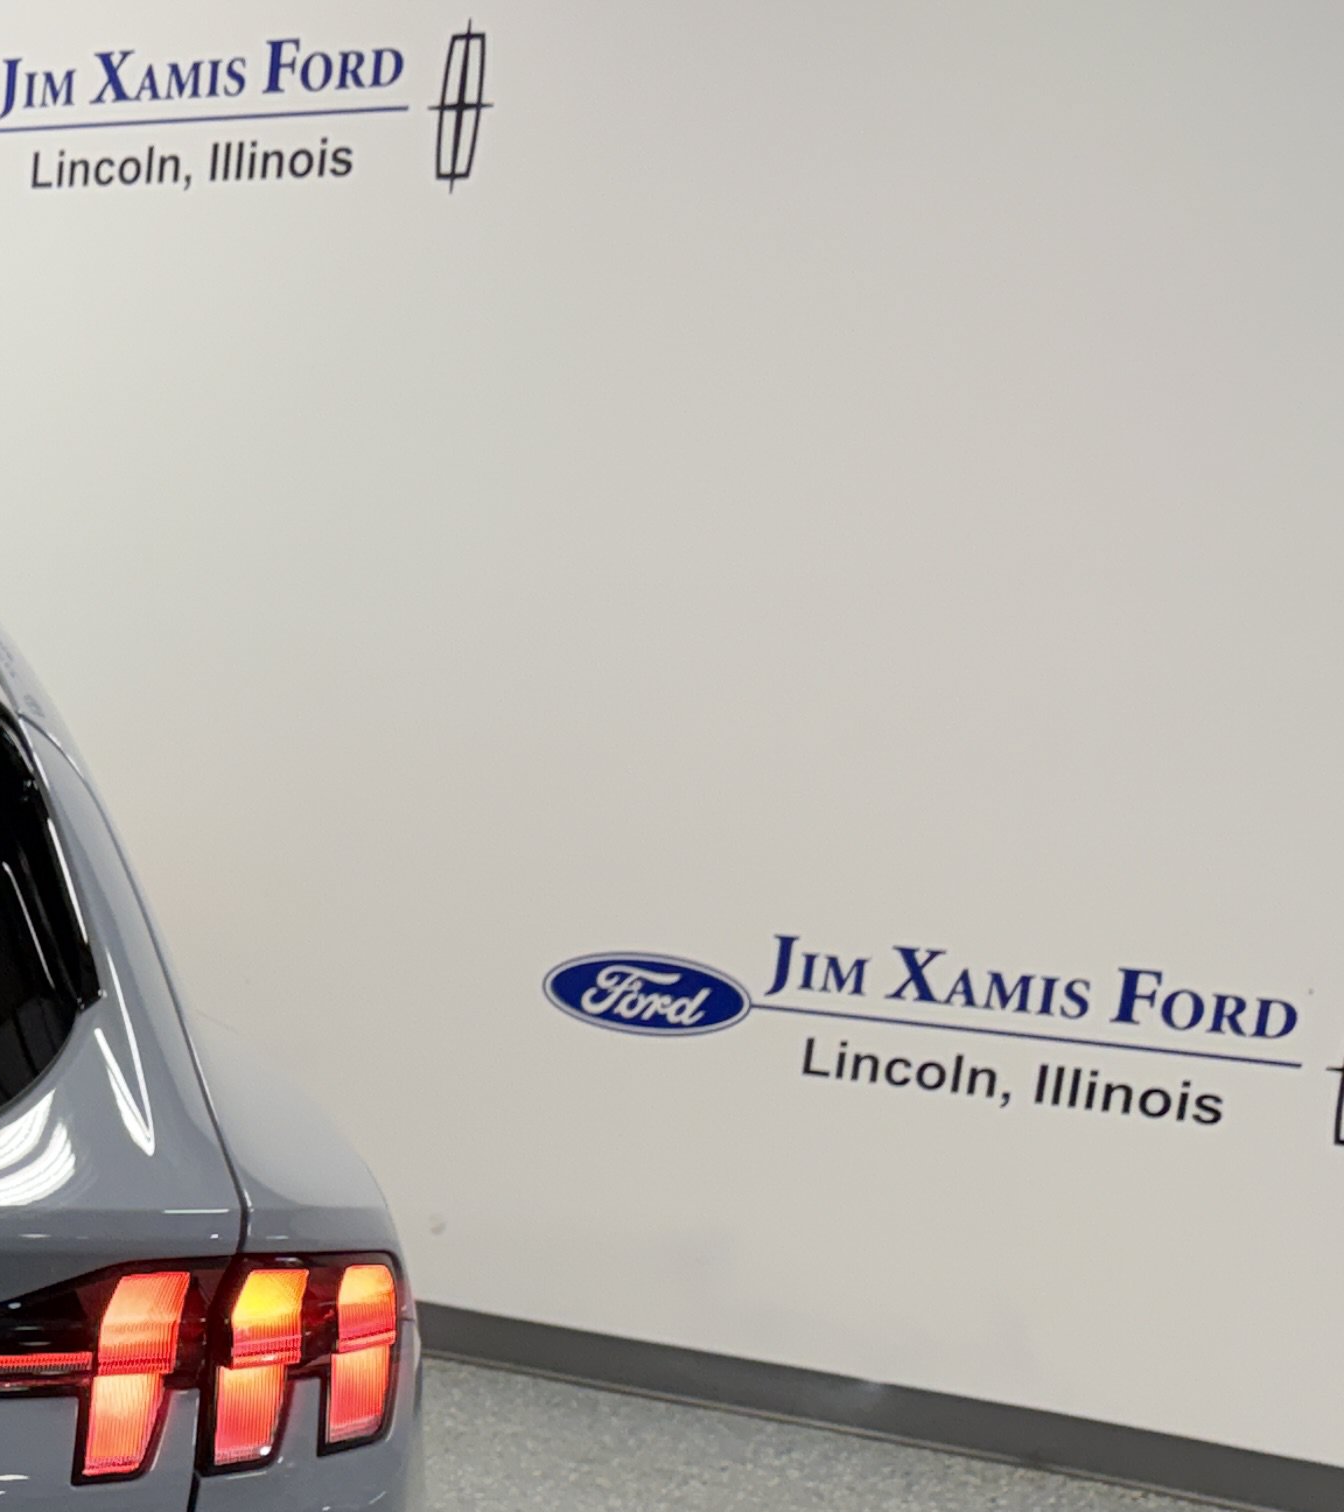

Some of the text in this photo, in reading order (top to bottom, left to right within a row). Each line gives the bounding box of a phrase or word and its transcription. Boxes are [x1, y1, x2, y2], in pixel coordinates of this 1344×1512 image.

[89, 49, 246, 105] XAMIS
[261, 38, 405, 95] FORD
[31, 137, 353, 191] Lincoln, Illinois
[580, 965, 710, 1025] Ford
[764, 934, 1299, 1041] JIM XAMIS FORD
[801, 1037, 1225, 1126] Lincoln, Illinois
